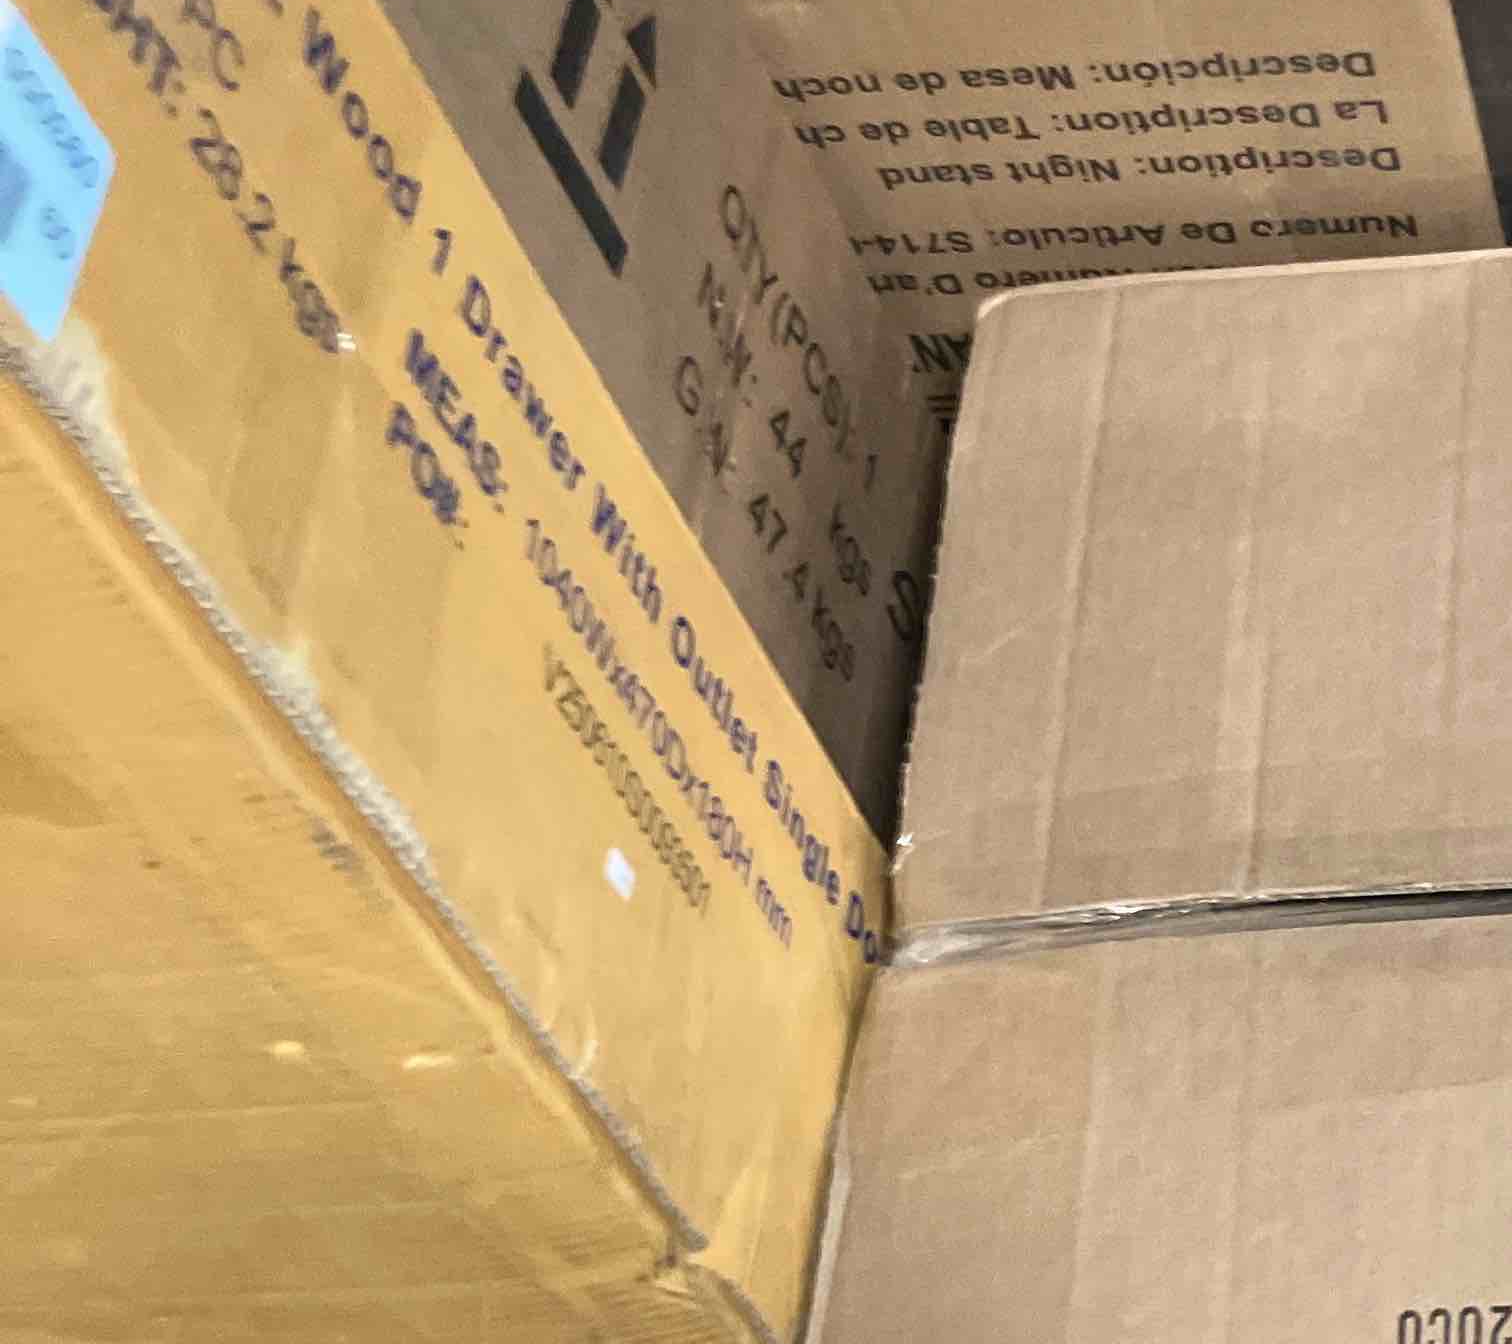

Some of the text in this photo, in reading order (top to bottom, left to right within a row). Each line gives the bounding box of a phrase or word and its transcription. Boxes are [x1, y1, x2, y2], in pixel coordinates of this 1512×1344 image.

[772, 51, 1377, 103] Descripción: Mesa de noch
[925, 111, 1041, 141] Table
[1055, 101, 1321, 135] Description:
[1335, 99, 1390, 125] La
[861, 116, 909, 143] de
[878, 146, 1400, 191] Description: Night stand
[990, 226, 1164, 250] Articulo:
[1181, 218, 1236, 245] De
[1253, 212, 1419, 240] Numero
[303, 6, 424, 224] Wood
[432, 228, 452, 276] 1
[458, 272, 586, 492] Drawer
[590, 482, 663, 624] With
[670, 614, 757, 774] Outlet
[763, 759, 840, 906] Single
